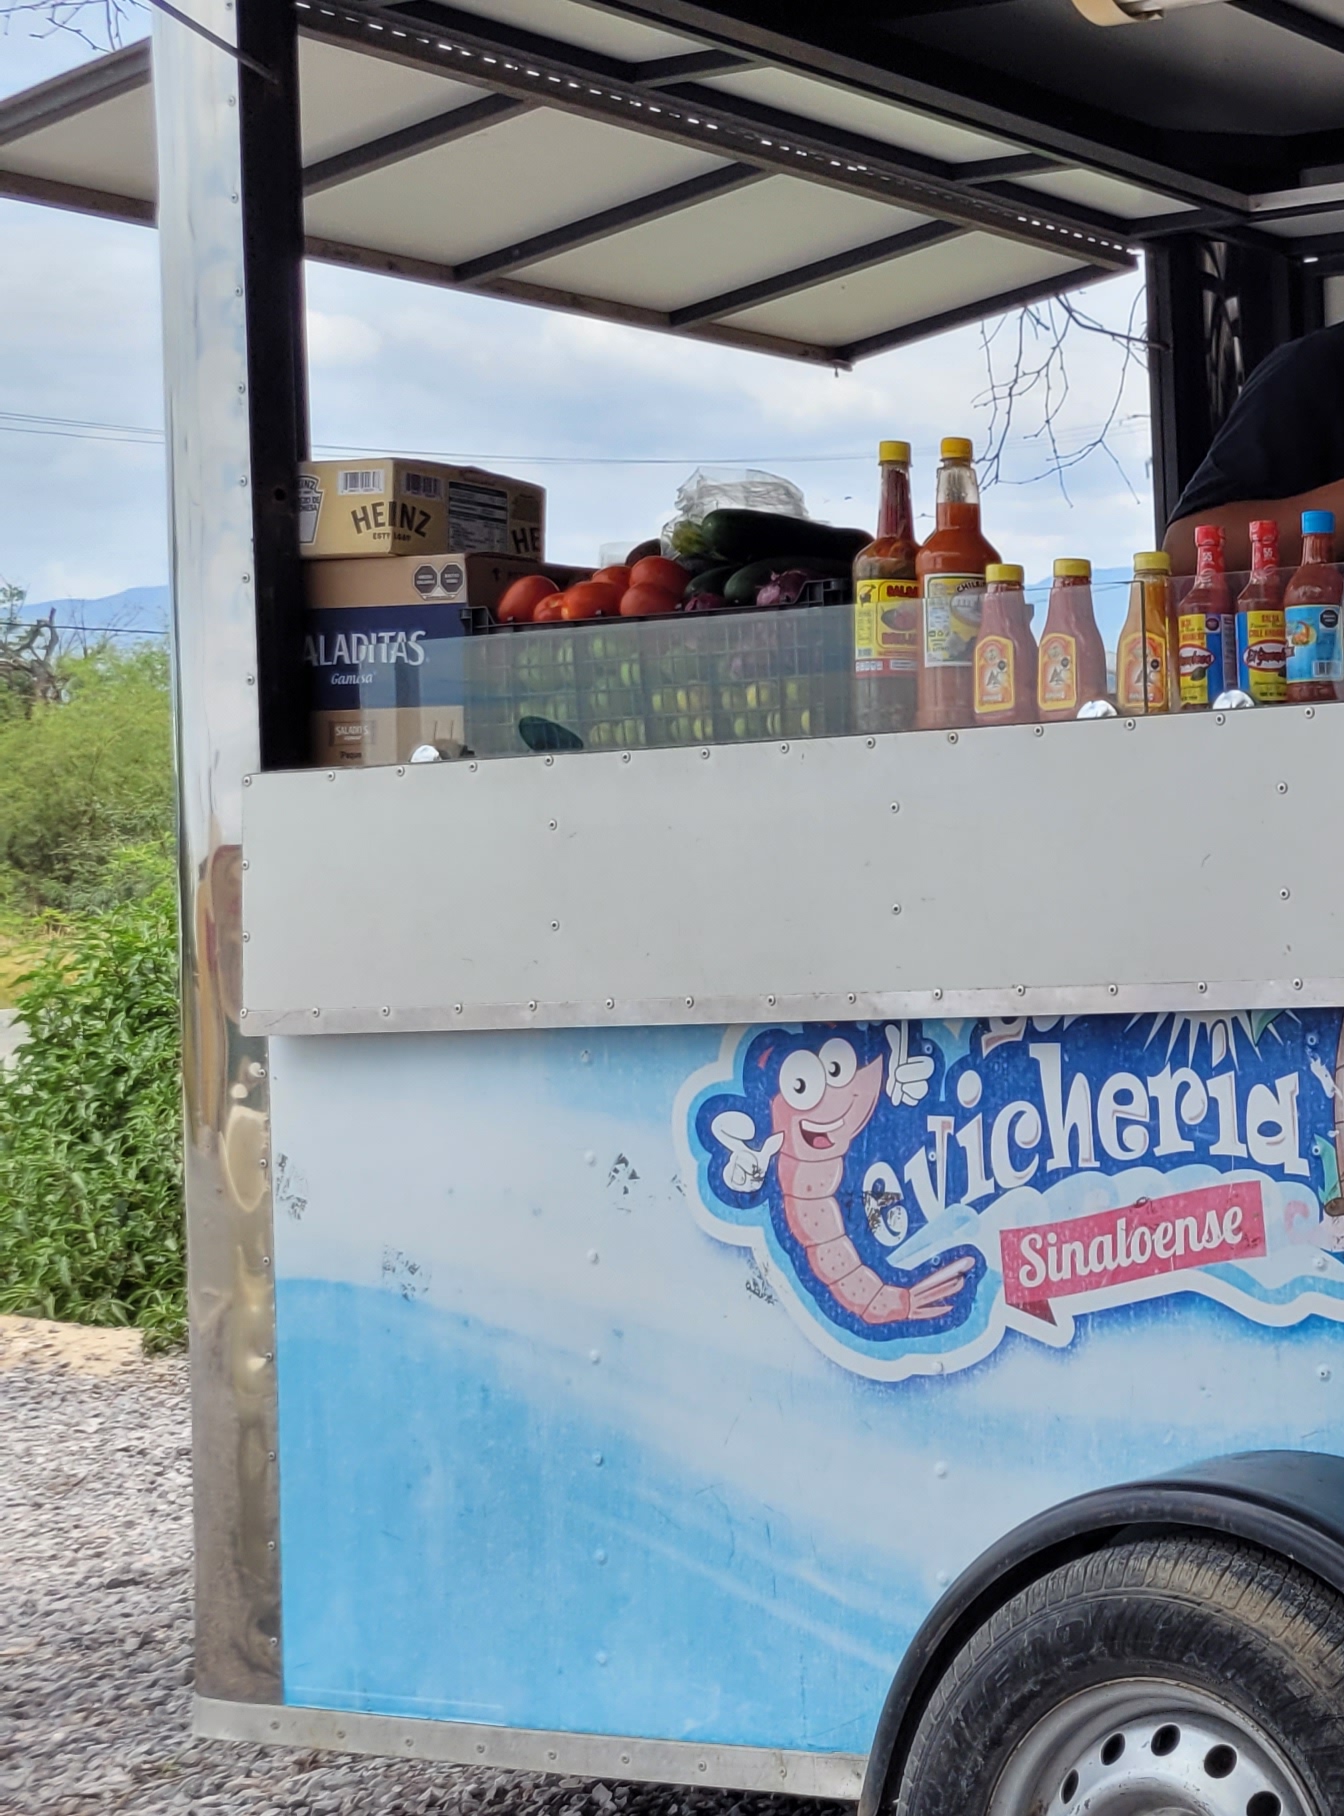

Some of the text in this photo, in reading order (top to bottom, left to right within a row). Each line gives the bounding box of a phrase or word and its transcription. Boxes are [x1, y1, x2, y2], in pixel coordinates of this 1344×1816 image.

[351, 501, 432, 538] HEINZ
[304, 630, 426, 667] ALADITAS
[1018, 1206, 1244, 1289] Sinaloense
